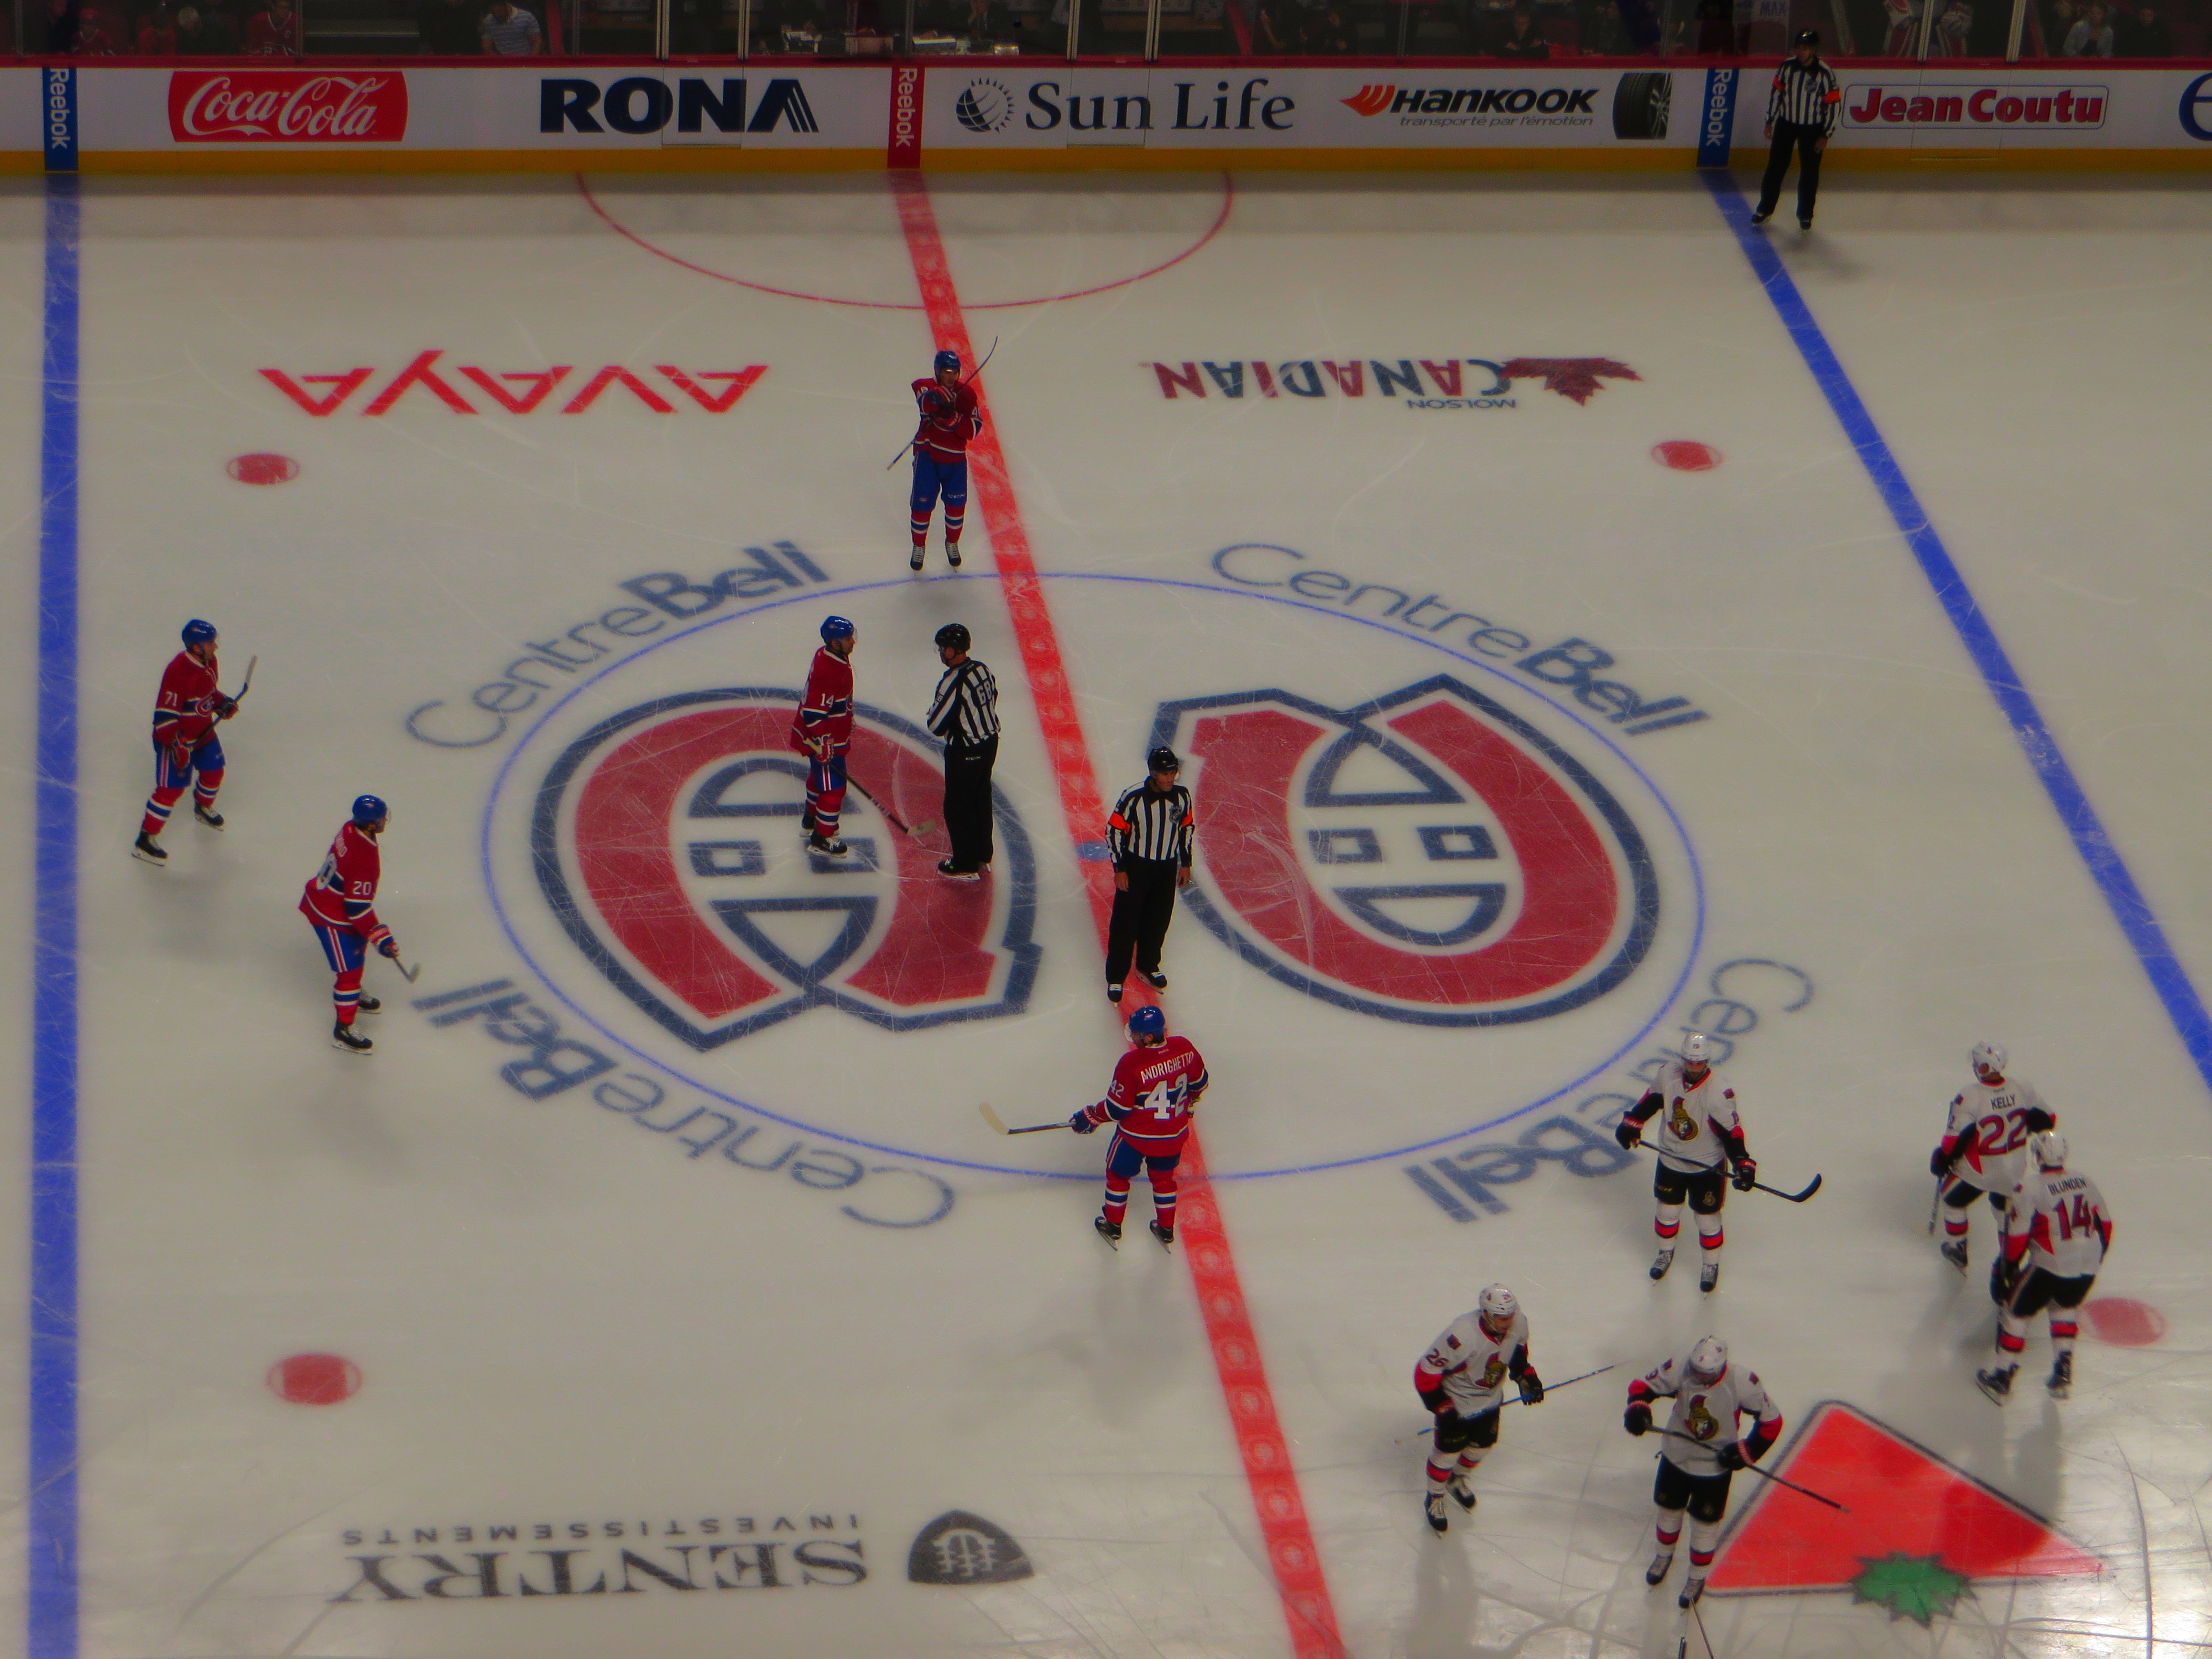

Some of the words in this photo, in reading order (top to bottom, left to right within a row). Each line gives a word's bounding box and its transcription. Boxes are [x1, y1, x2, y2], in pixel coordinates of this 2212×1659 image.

[50, 68, 71, 149] Reebok
[183, 76, 389, 137] Coca-Cola
[540, 77, 820, 134] RONA
[895, 67, 918, 148] Reebok
[1025, 82, 1154, 130] Sun
[1171, 78, 1295, 131] Life
[1400, 114, 1488, 128] transporté
[1489, 117, 1514, 128] par
[1519, 115, 1593, 127] l'émotion
[1705, 69, 1733, 147] Reebok
[1849, 88, 1963, 123] Jean
[1967, 88, 2103, 123] Coutu
[258, 350, 768, 416] AVAYA
[1152, 359, 1514, 398] CANADIAN
[1406, 399, 1516, 409] MOLSON
[165, 691, 178, 707] 71
[820, 693, 835, 708] 14
[975, 680, 992, 706] 68
[352, 881, 372, 895] 20
[1140, 1051, 1194, 1083] ANDRIGHETTO
[1110, 1079, 1125, 1099] 42
[1144, 1072, 1188, 1119] 42
[1991, 1094, 2016, 1110] KELLY
[1978, 1108, 2028, 1155] 22
[2053, 1194, 2091, 1240] 14
[342, 1514, 858, 1546] INVESTISSEMENTS
[327, 1540, 867, 1602] SENTRY
